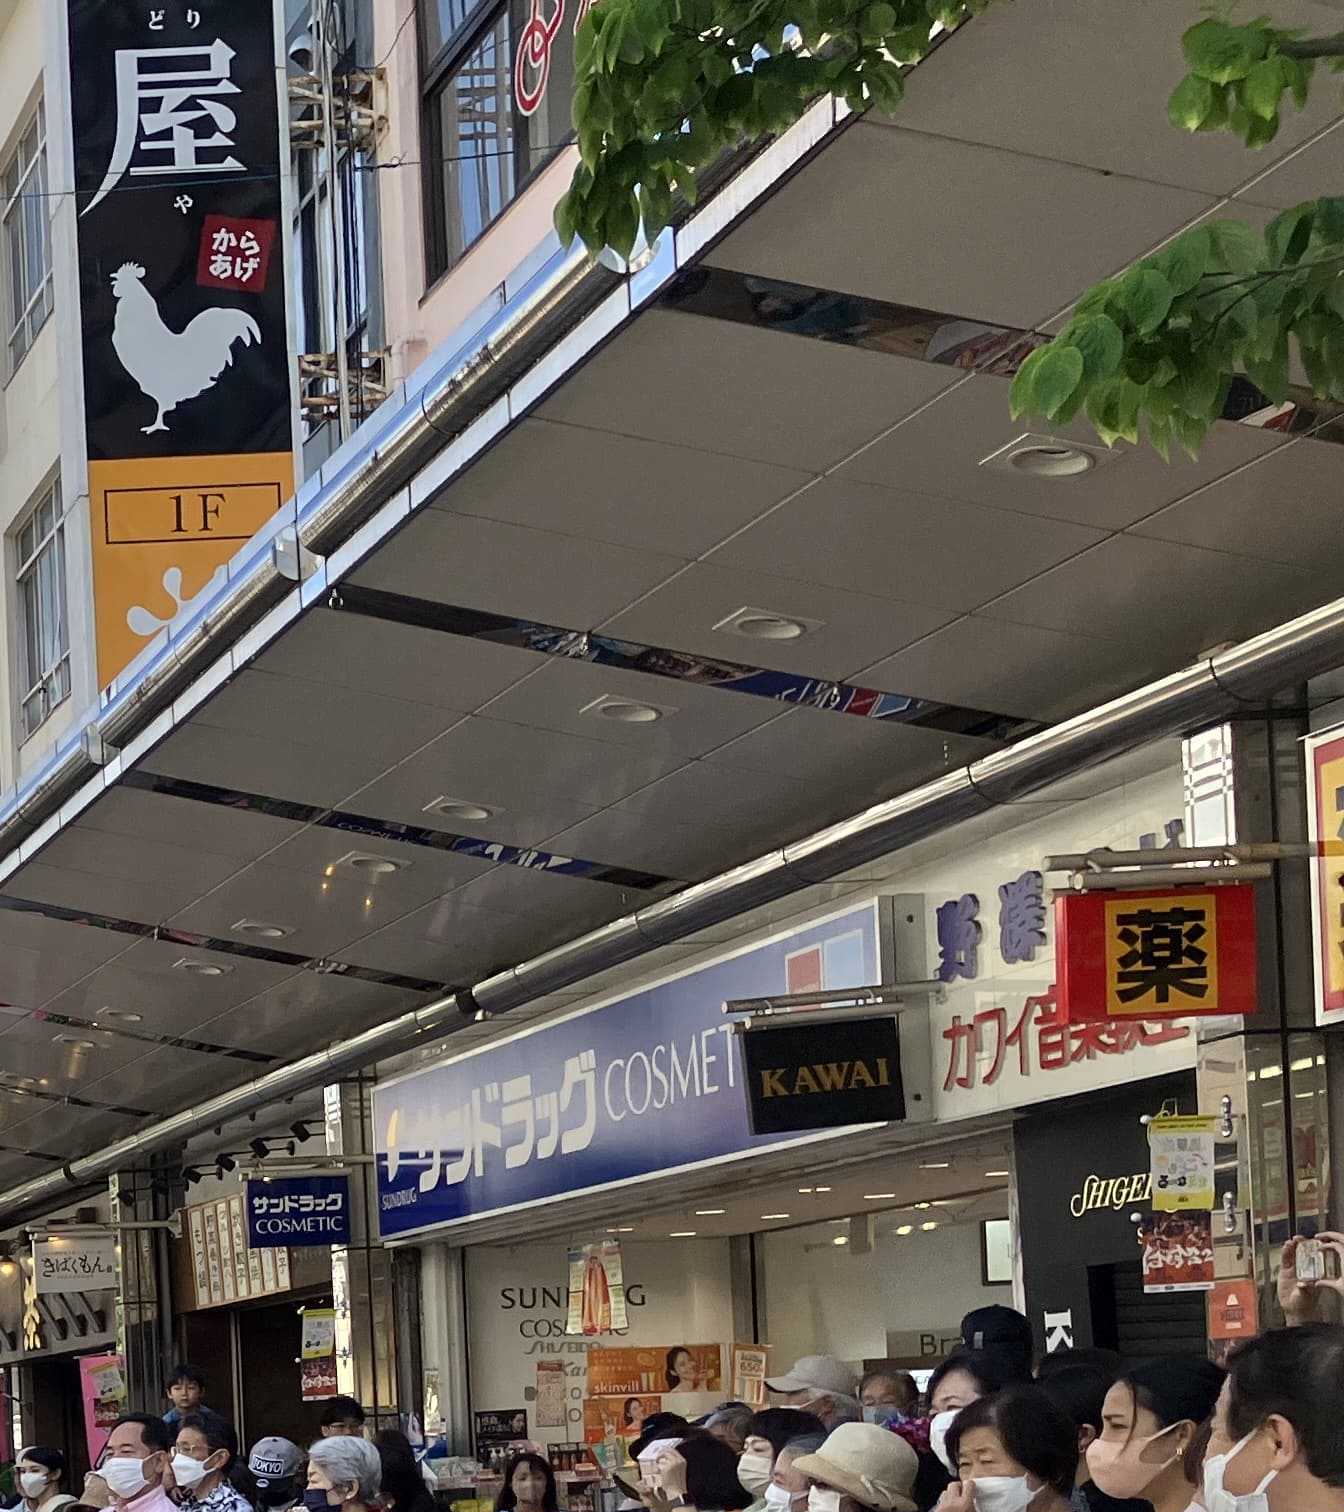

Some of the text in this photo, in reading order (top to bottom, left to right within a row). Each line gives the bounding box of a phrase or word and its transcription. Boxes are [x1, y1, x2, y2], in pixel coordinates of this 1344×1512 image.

[147, 8, 202, 31] どり
[79, 38, 248, 219] 屋
[173, 193, 194, 214] や
[169, 493, 226, 533] 1F
[1115, 906, 1209, 1004] 薬
[760, 1057, 891, 1099] KAWAI
[413, 1048, 597, 1193] サンドラッグ
[252, 1193, 343, 1215] サンドラッグ
[1070, 1172, 1153, 1217] SHIGE
[255, 1215, 344, 1235] COSMETIC
[501, 1284, 647, 1309] SUNG
[593, 1380, 639, 1393] skinvill
[253, 1458, 281, 1473] TOKYO
